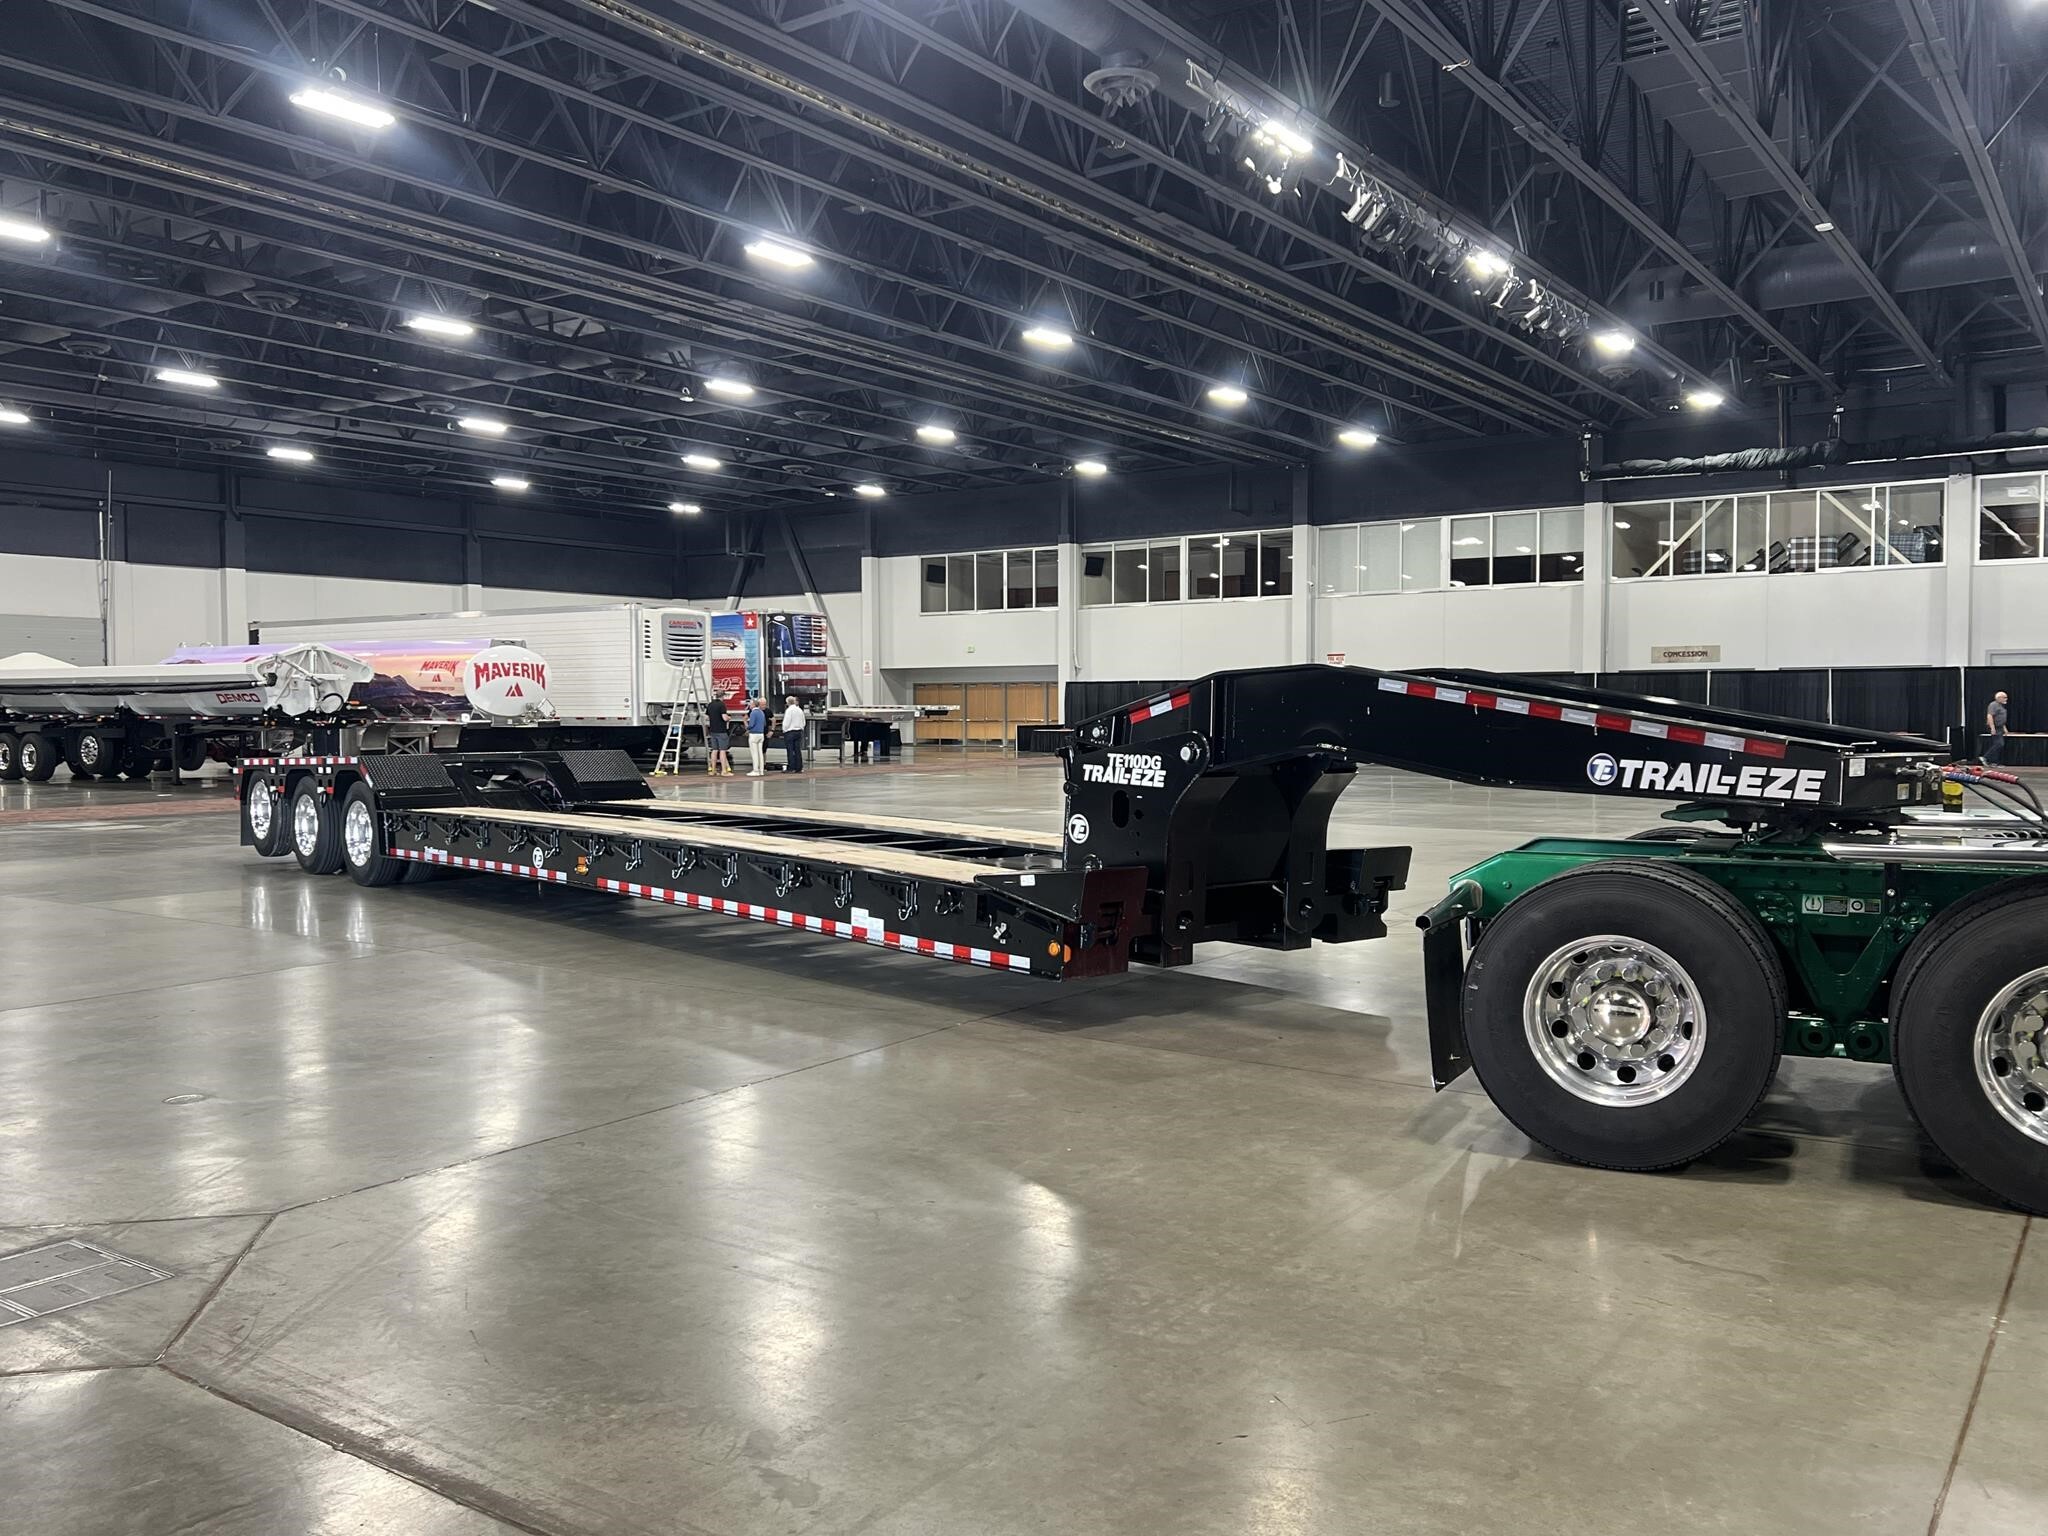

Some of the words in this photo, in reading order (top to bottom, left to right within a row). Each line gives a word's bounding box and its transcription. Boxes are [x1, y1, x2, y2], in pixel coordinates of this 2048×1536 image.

[1663, 650, 1708, 658] CONCESSION
[419, 660, 460, 676] MAVERIK
[473, 662, 546, 690] MAVERIK
[215, 693, 261, 704] DEMCO
[1107, 753, 1162, 770] TE110DG
[1082, 764, 1167, 788] TRAIL-EZE
[1618, 759, 1828, 801] TRAIL-EZE
